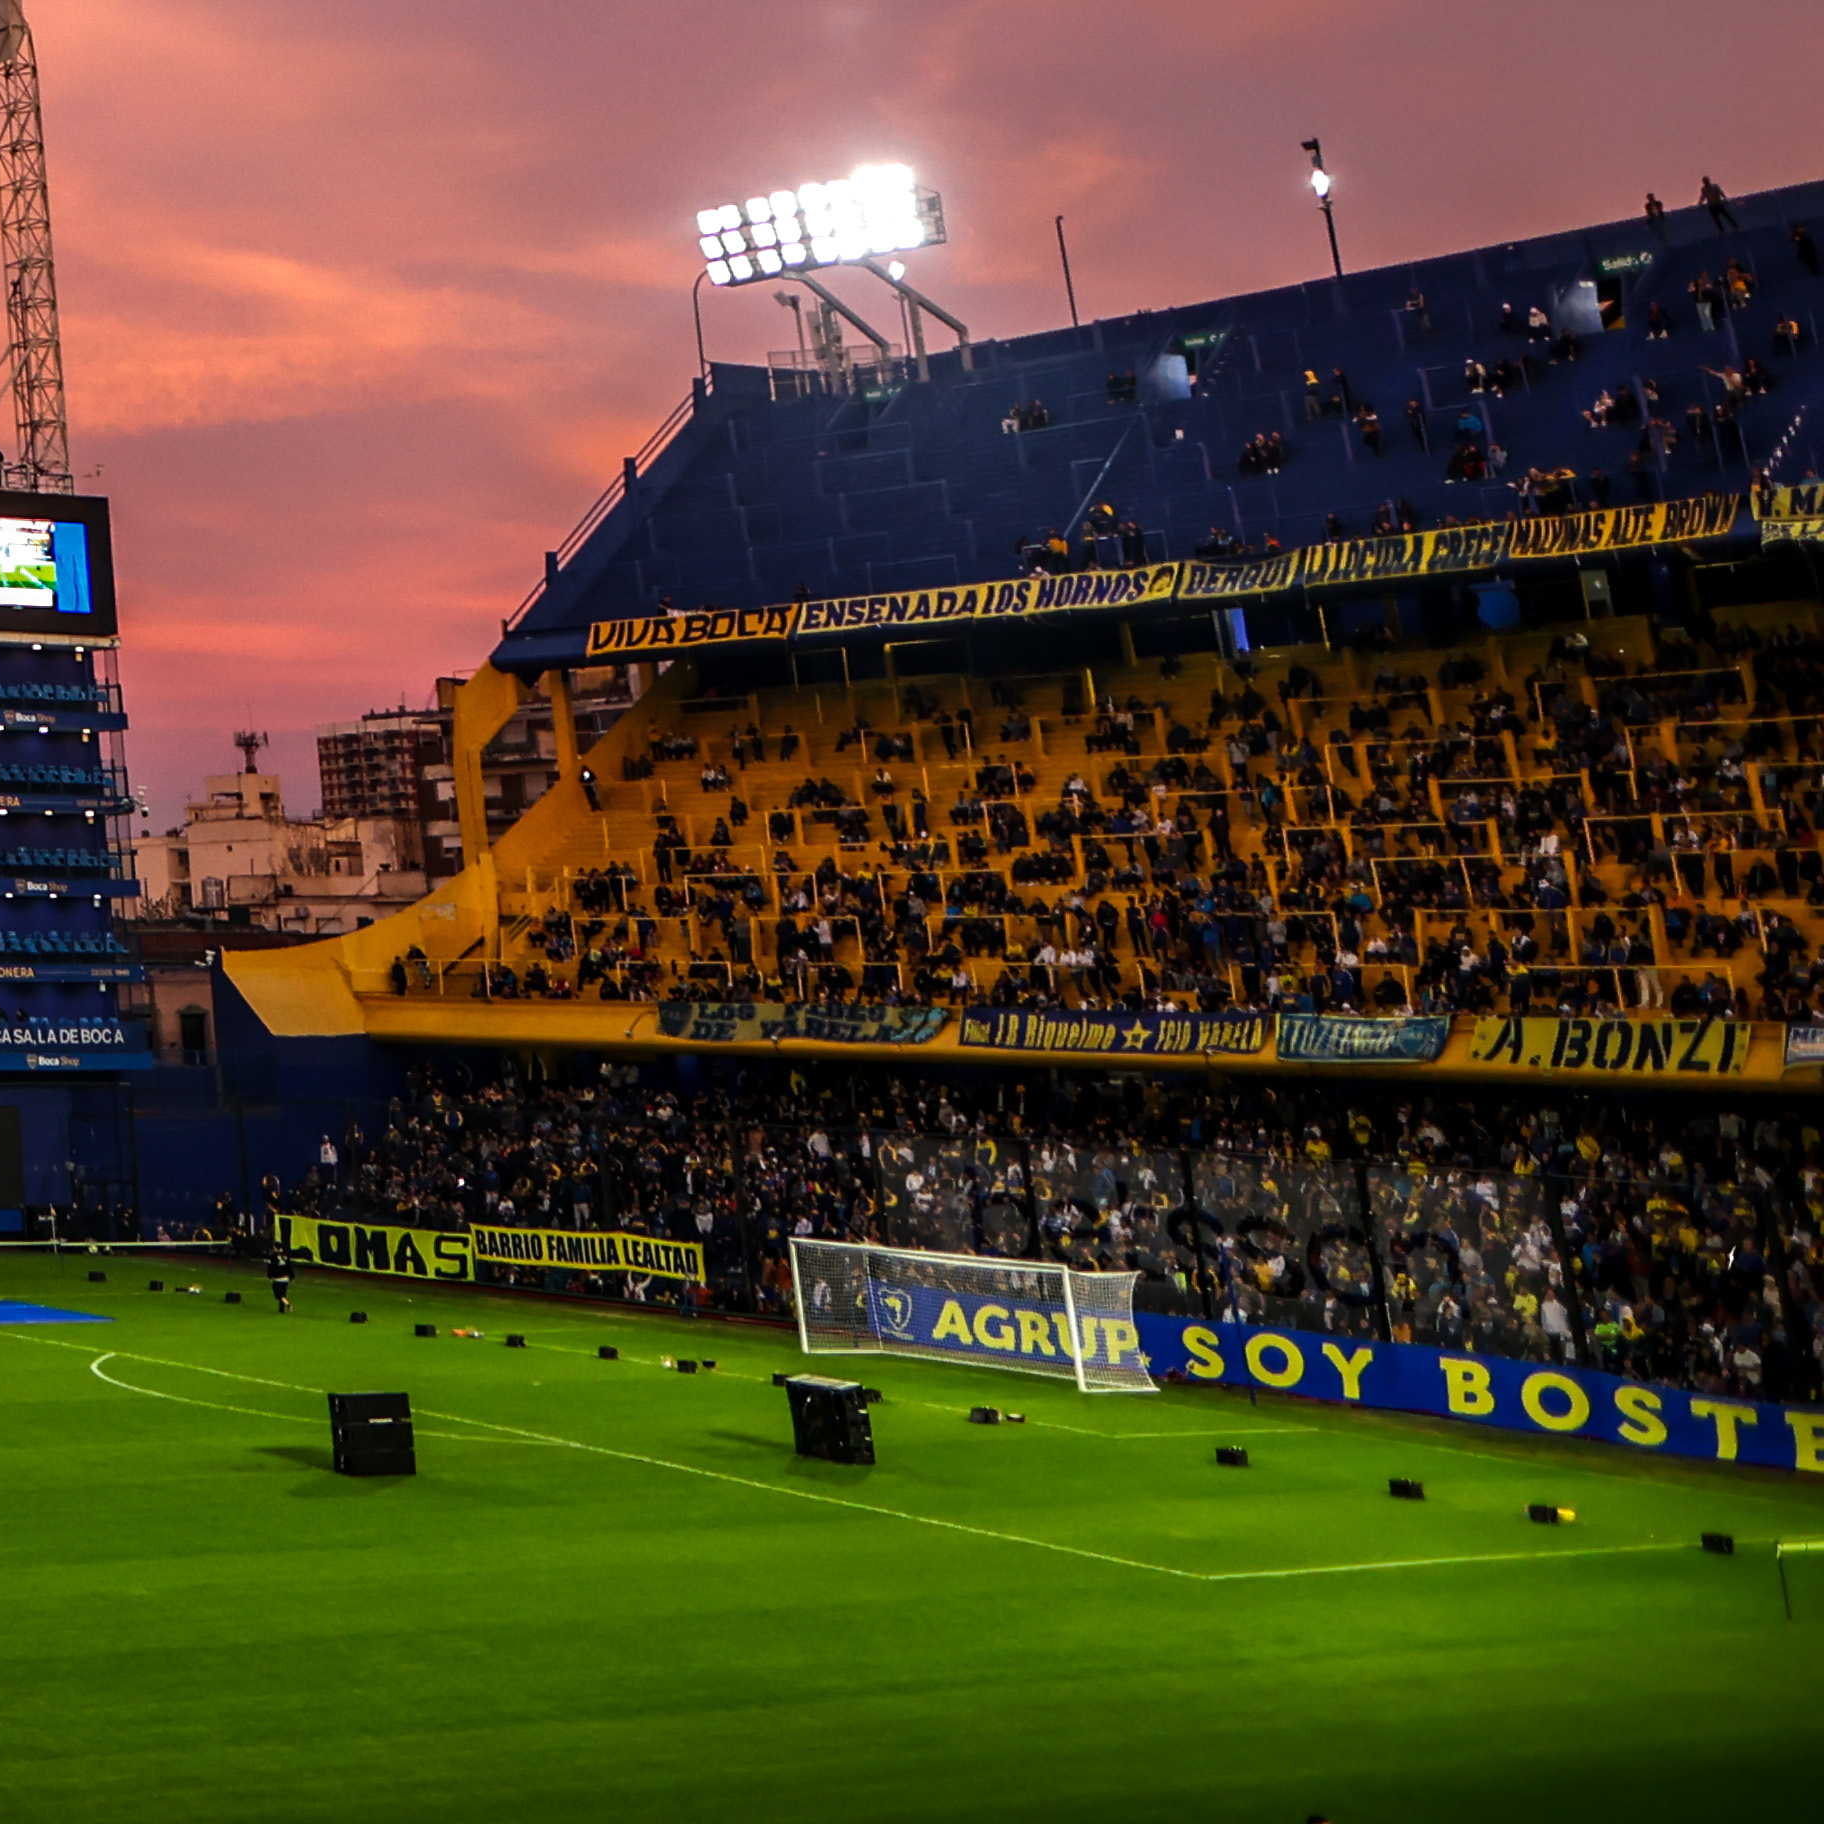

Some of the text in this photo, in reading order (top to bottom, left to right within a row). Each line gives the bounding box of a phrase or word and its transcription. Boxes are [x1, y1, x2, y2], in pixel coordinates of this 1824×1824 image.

[803, 570, 1148, 629] ENSENADA LOS HORNOS
[591, 607, 794, 650] VIVA BOCA
[27, 882, 48, 891] Boca
[81, 1029, 125, 1044] BOCA
[1024, 1014, 1116, 1050] Riquelme
[38, 1056, 60, 1066] Boca
[278, 1217, 472, 1280] LOMAS
[475, 1229, 699, 1275] BARRIO FAMILIA LEALTAD
[933, 1300, 1139, 1364] AGRUP
[1182, 1326, 1372, 1399] SOY
